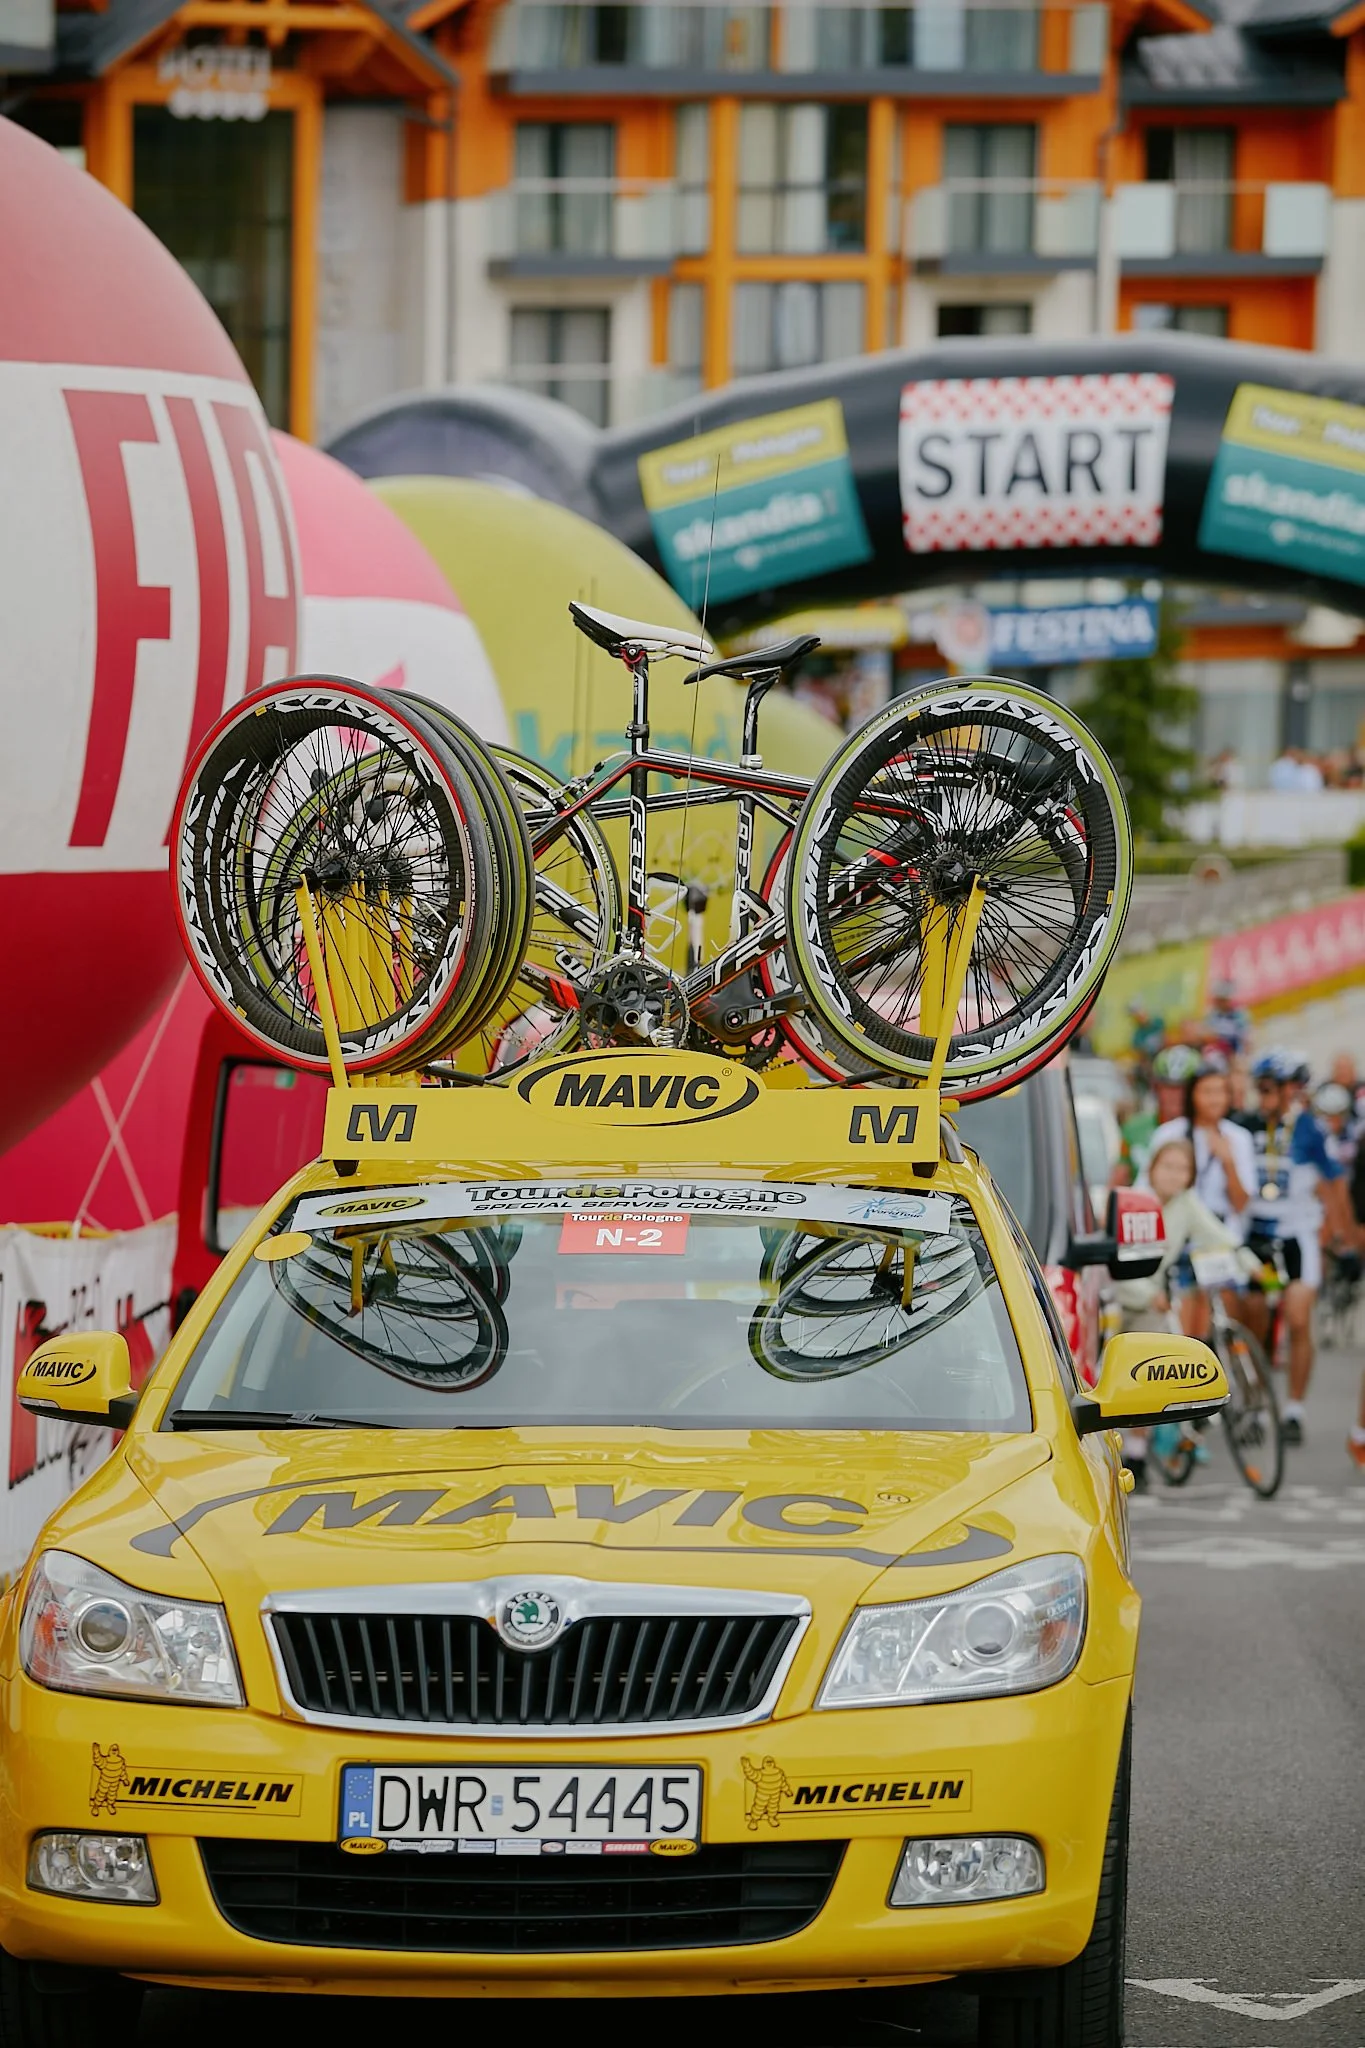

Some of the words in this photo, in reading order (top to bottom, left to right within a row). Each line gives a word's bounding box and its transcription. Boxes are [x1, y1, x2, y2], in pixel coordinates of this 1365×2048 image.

[915, 426, 1154, 499] START
[553, 1073, 721, 1110] MAVIC
[333, 1199, 407, 1214] MAVIC
[472, 1201, 574, 1211] SPECIAL
[580, 1200, 670, 1209] SERVIS
[676, 1201, 779, 1213] COURSE
[595, 1227, 663, 1247] N-2
[33, 1360, 85, 1380] MAVIC
[1146, 1363, 1209, 1382] MAVIC
[262, 1483, 870, 1536] MAVIC
[128, 1776, 294, 1803] MICHELIN
[793, 1779, 964, 1805] MICHELIN
[378, 1775, 487, 1832] DWR
[511, 1776, 690, 1833] 54445
[348, 1812, 370, 1828] PL
[349, 1841, 378, 1850] MAVIC
[658, 1843, 688, 1851] MAVIC
